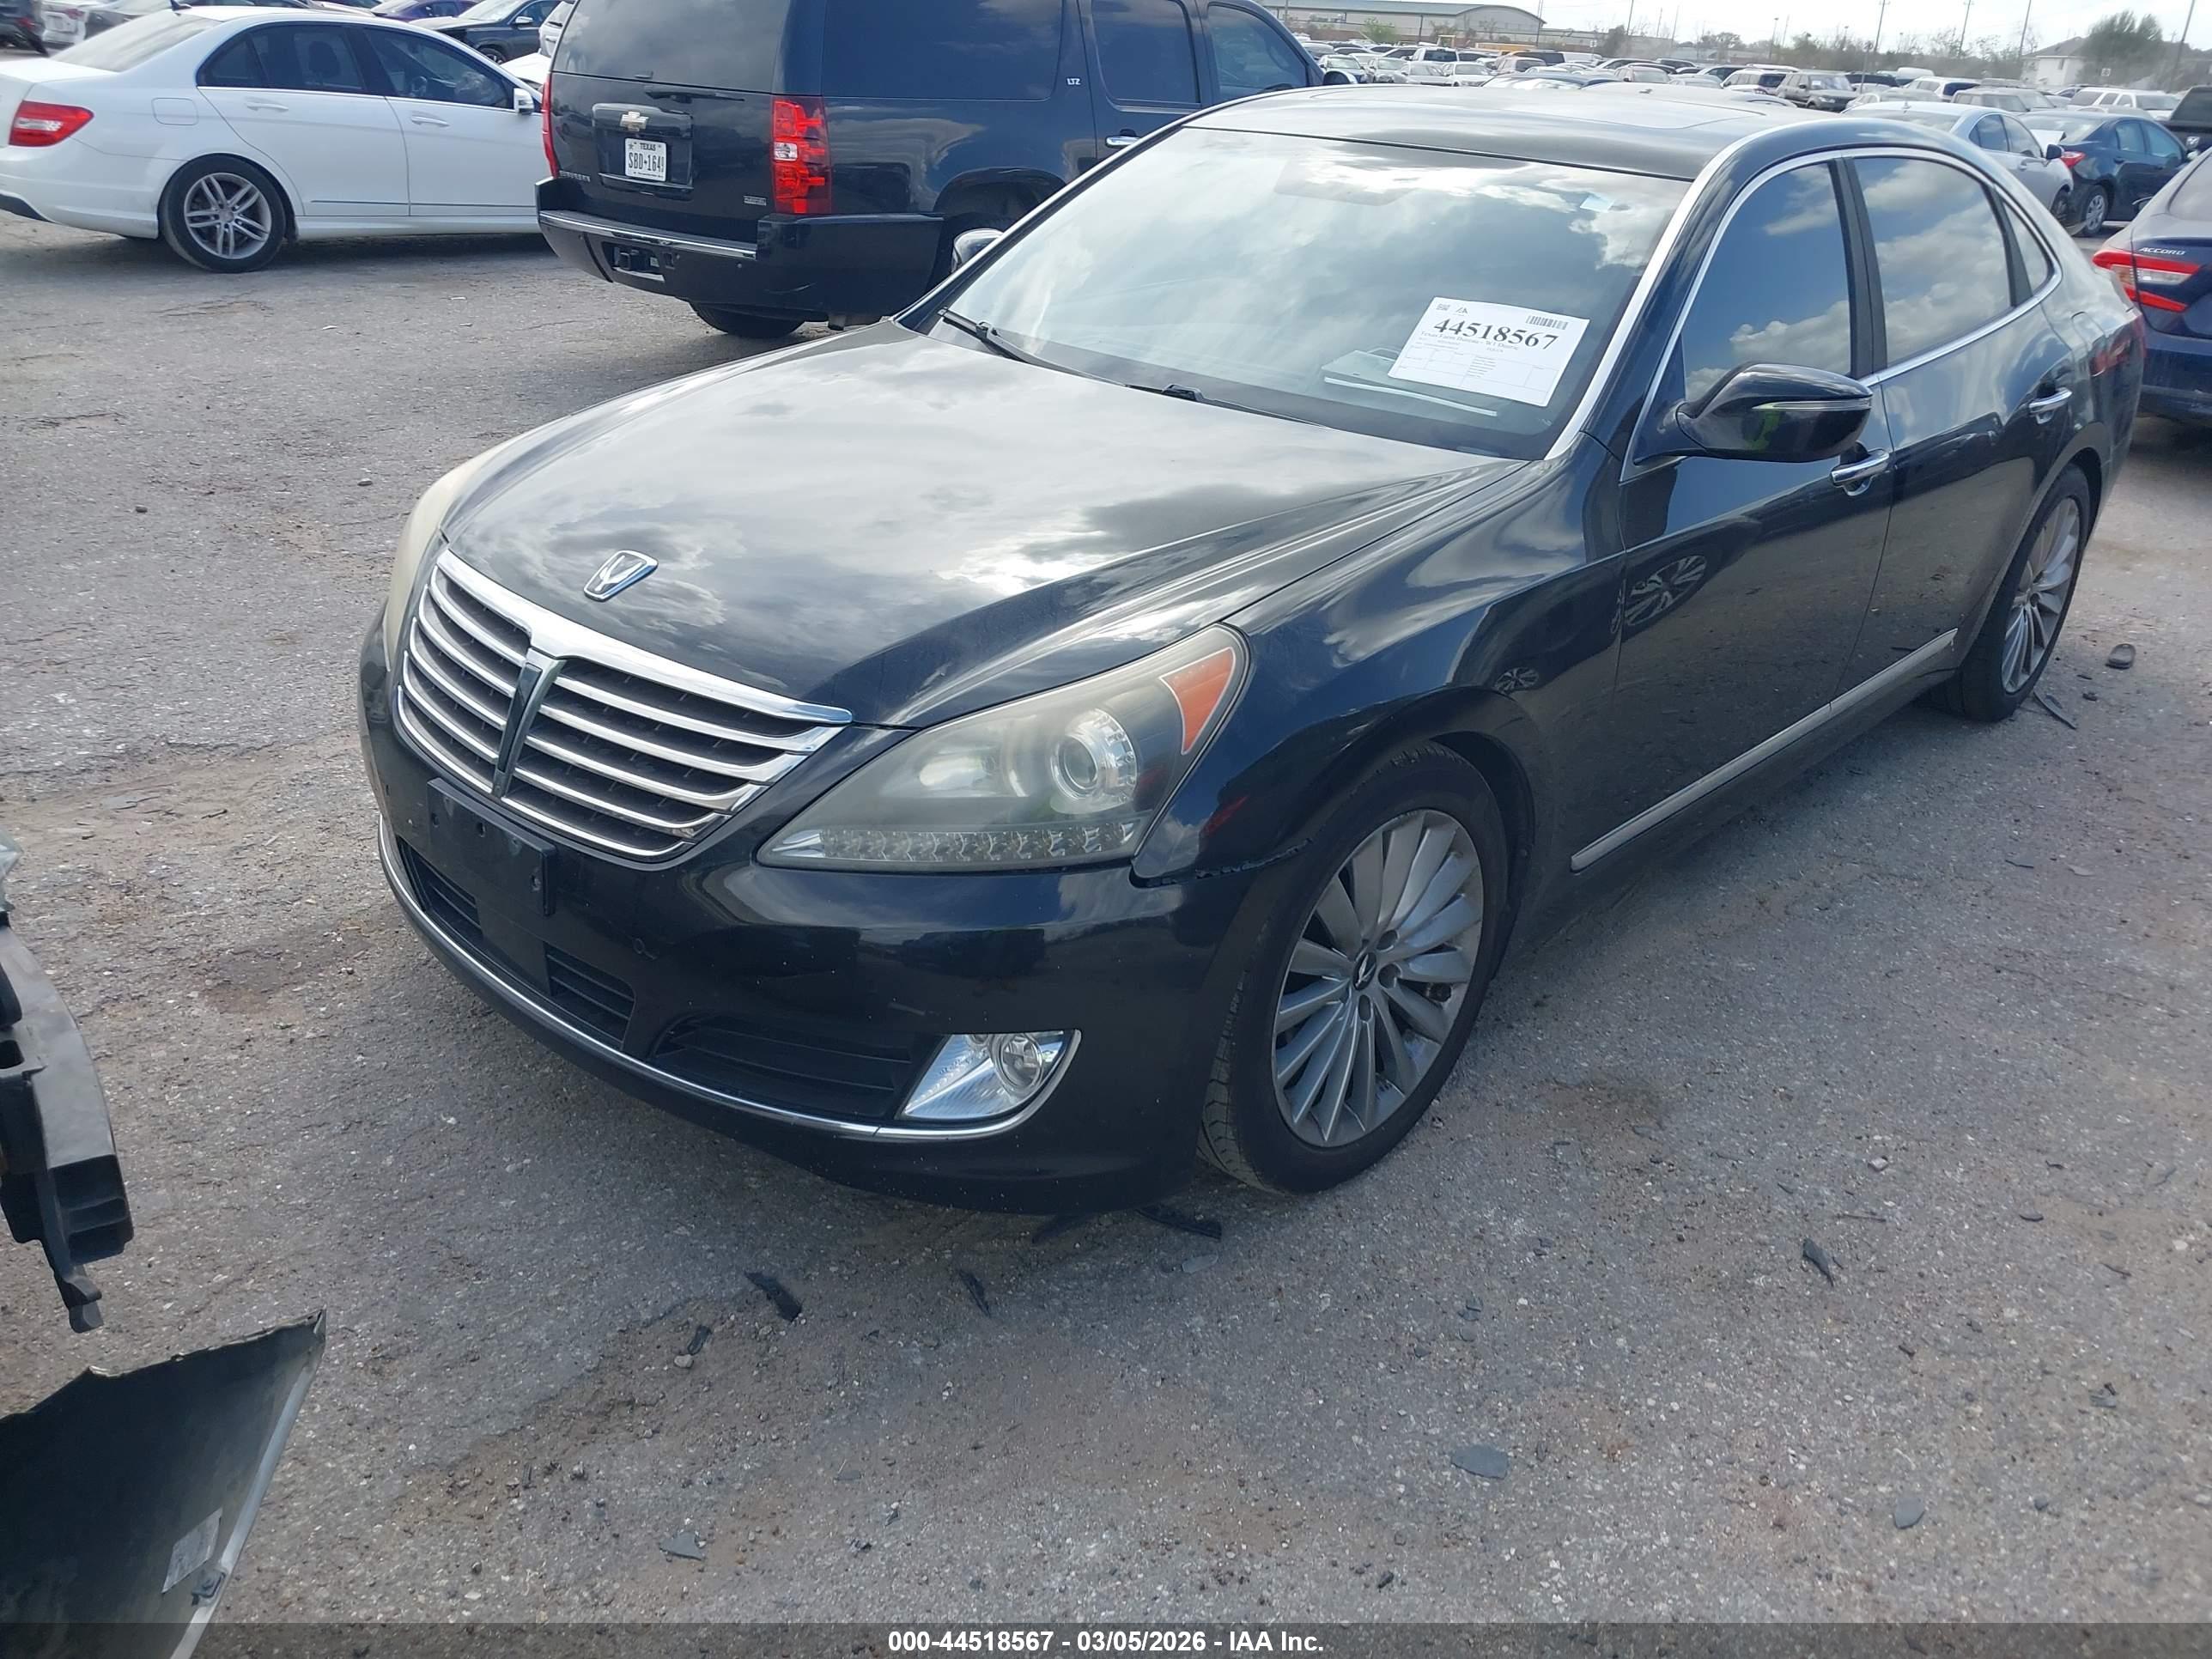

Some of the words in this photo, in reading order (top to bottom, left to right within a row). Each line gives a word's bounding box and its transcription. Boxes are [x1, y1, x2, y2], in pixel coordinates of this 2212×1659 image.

[639, 143, 656, 151] TEXAS
[2138, 246, 2187, 255] ACCORD
[1433, 318, 1559, 350] 44518567
